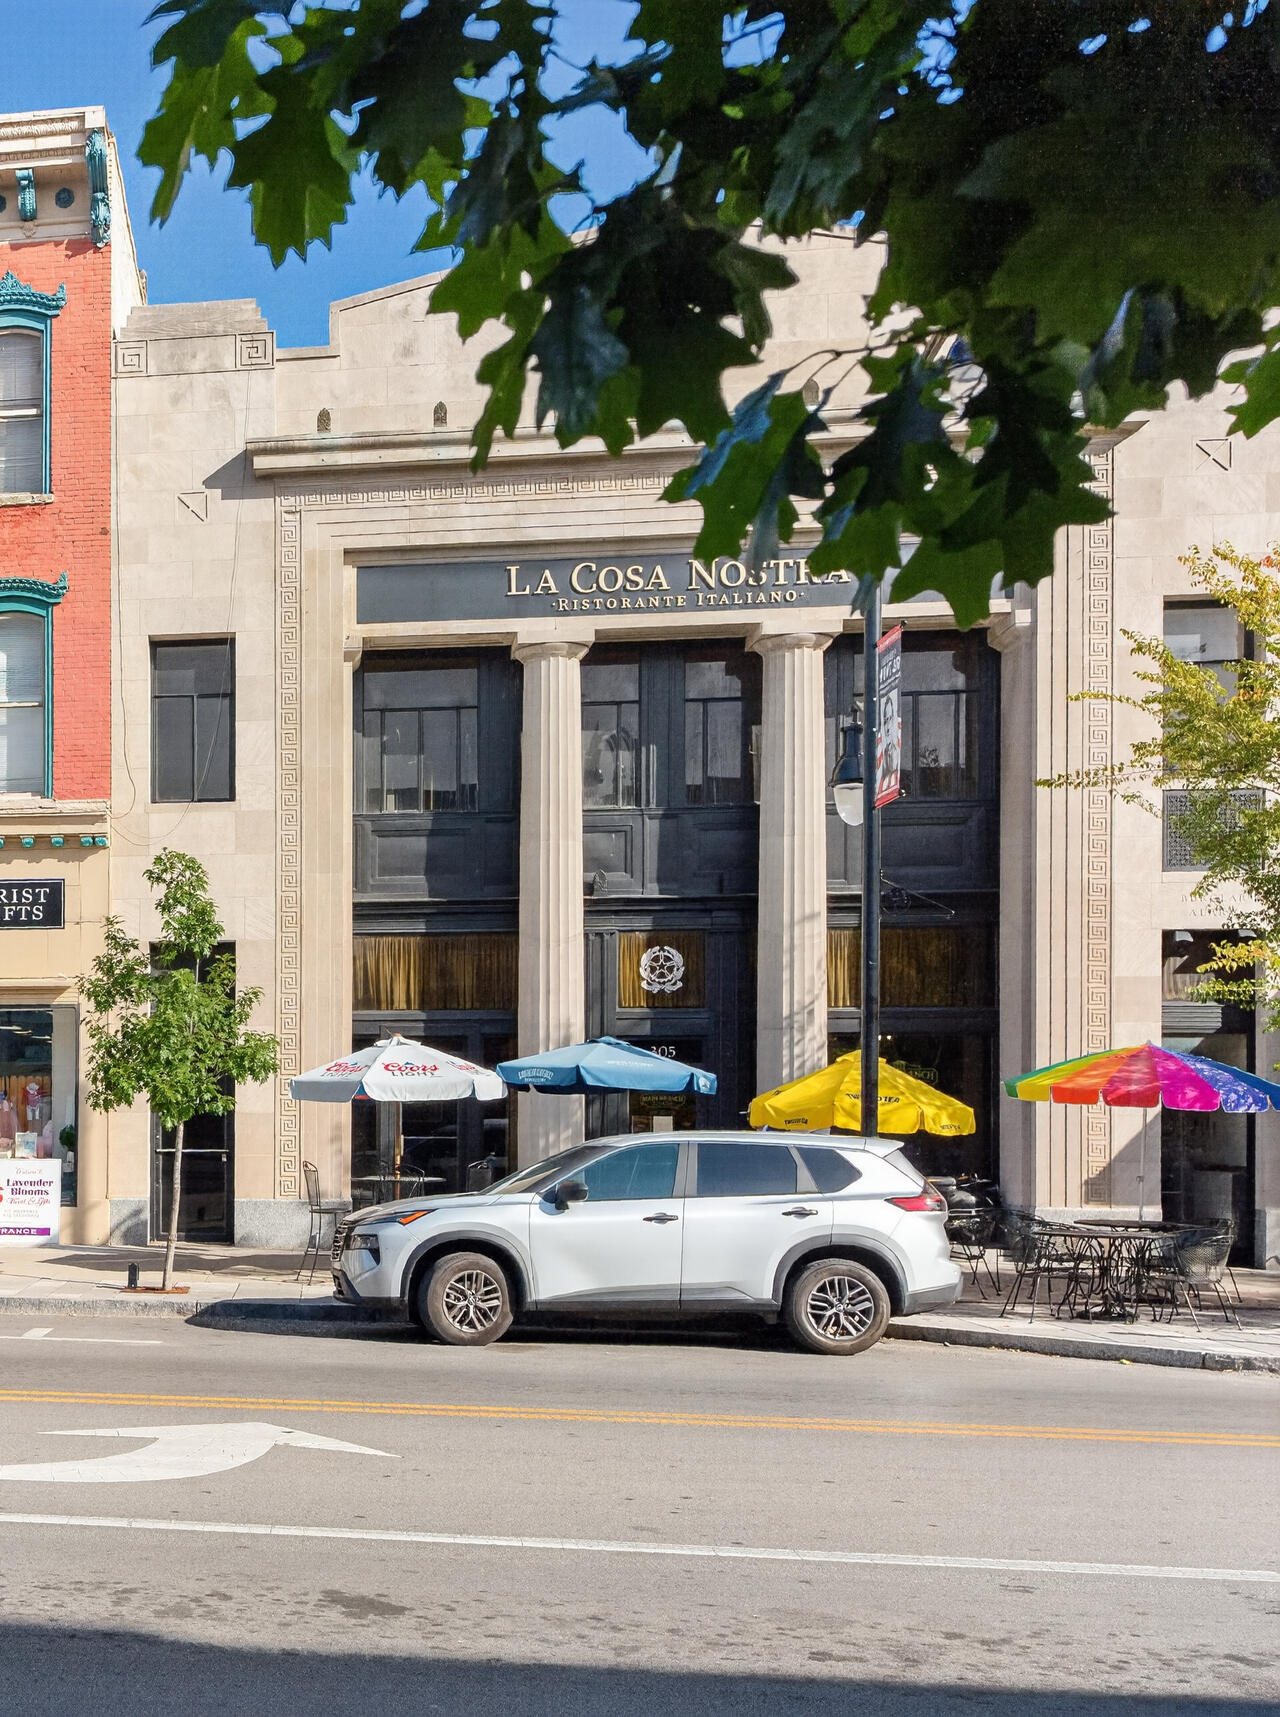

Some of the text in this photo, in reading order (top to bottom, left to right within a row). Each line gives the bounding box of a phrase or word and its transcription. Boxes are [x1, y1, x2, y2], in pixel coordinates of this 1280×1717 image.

[506, 565, 559, 595] LA
[571, 561, 670, 593] COSA
[558, 590, 797, 611] RISTORANTE ITALIANO
[383, 1061, 440, 1072] Coors
[6, 1178, 54, 1187] Lavender
[10, 1187, 50, 1196] Blooms
